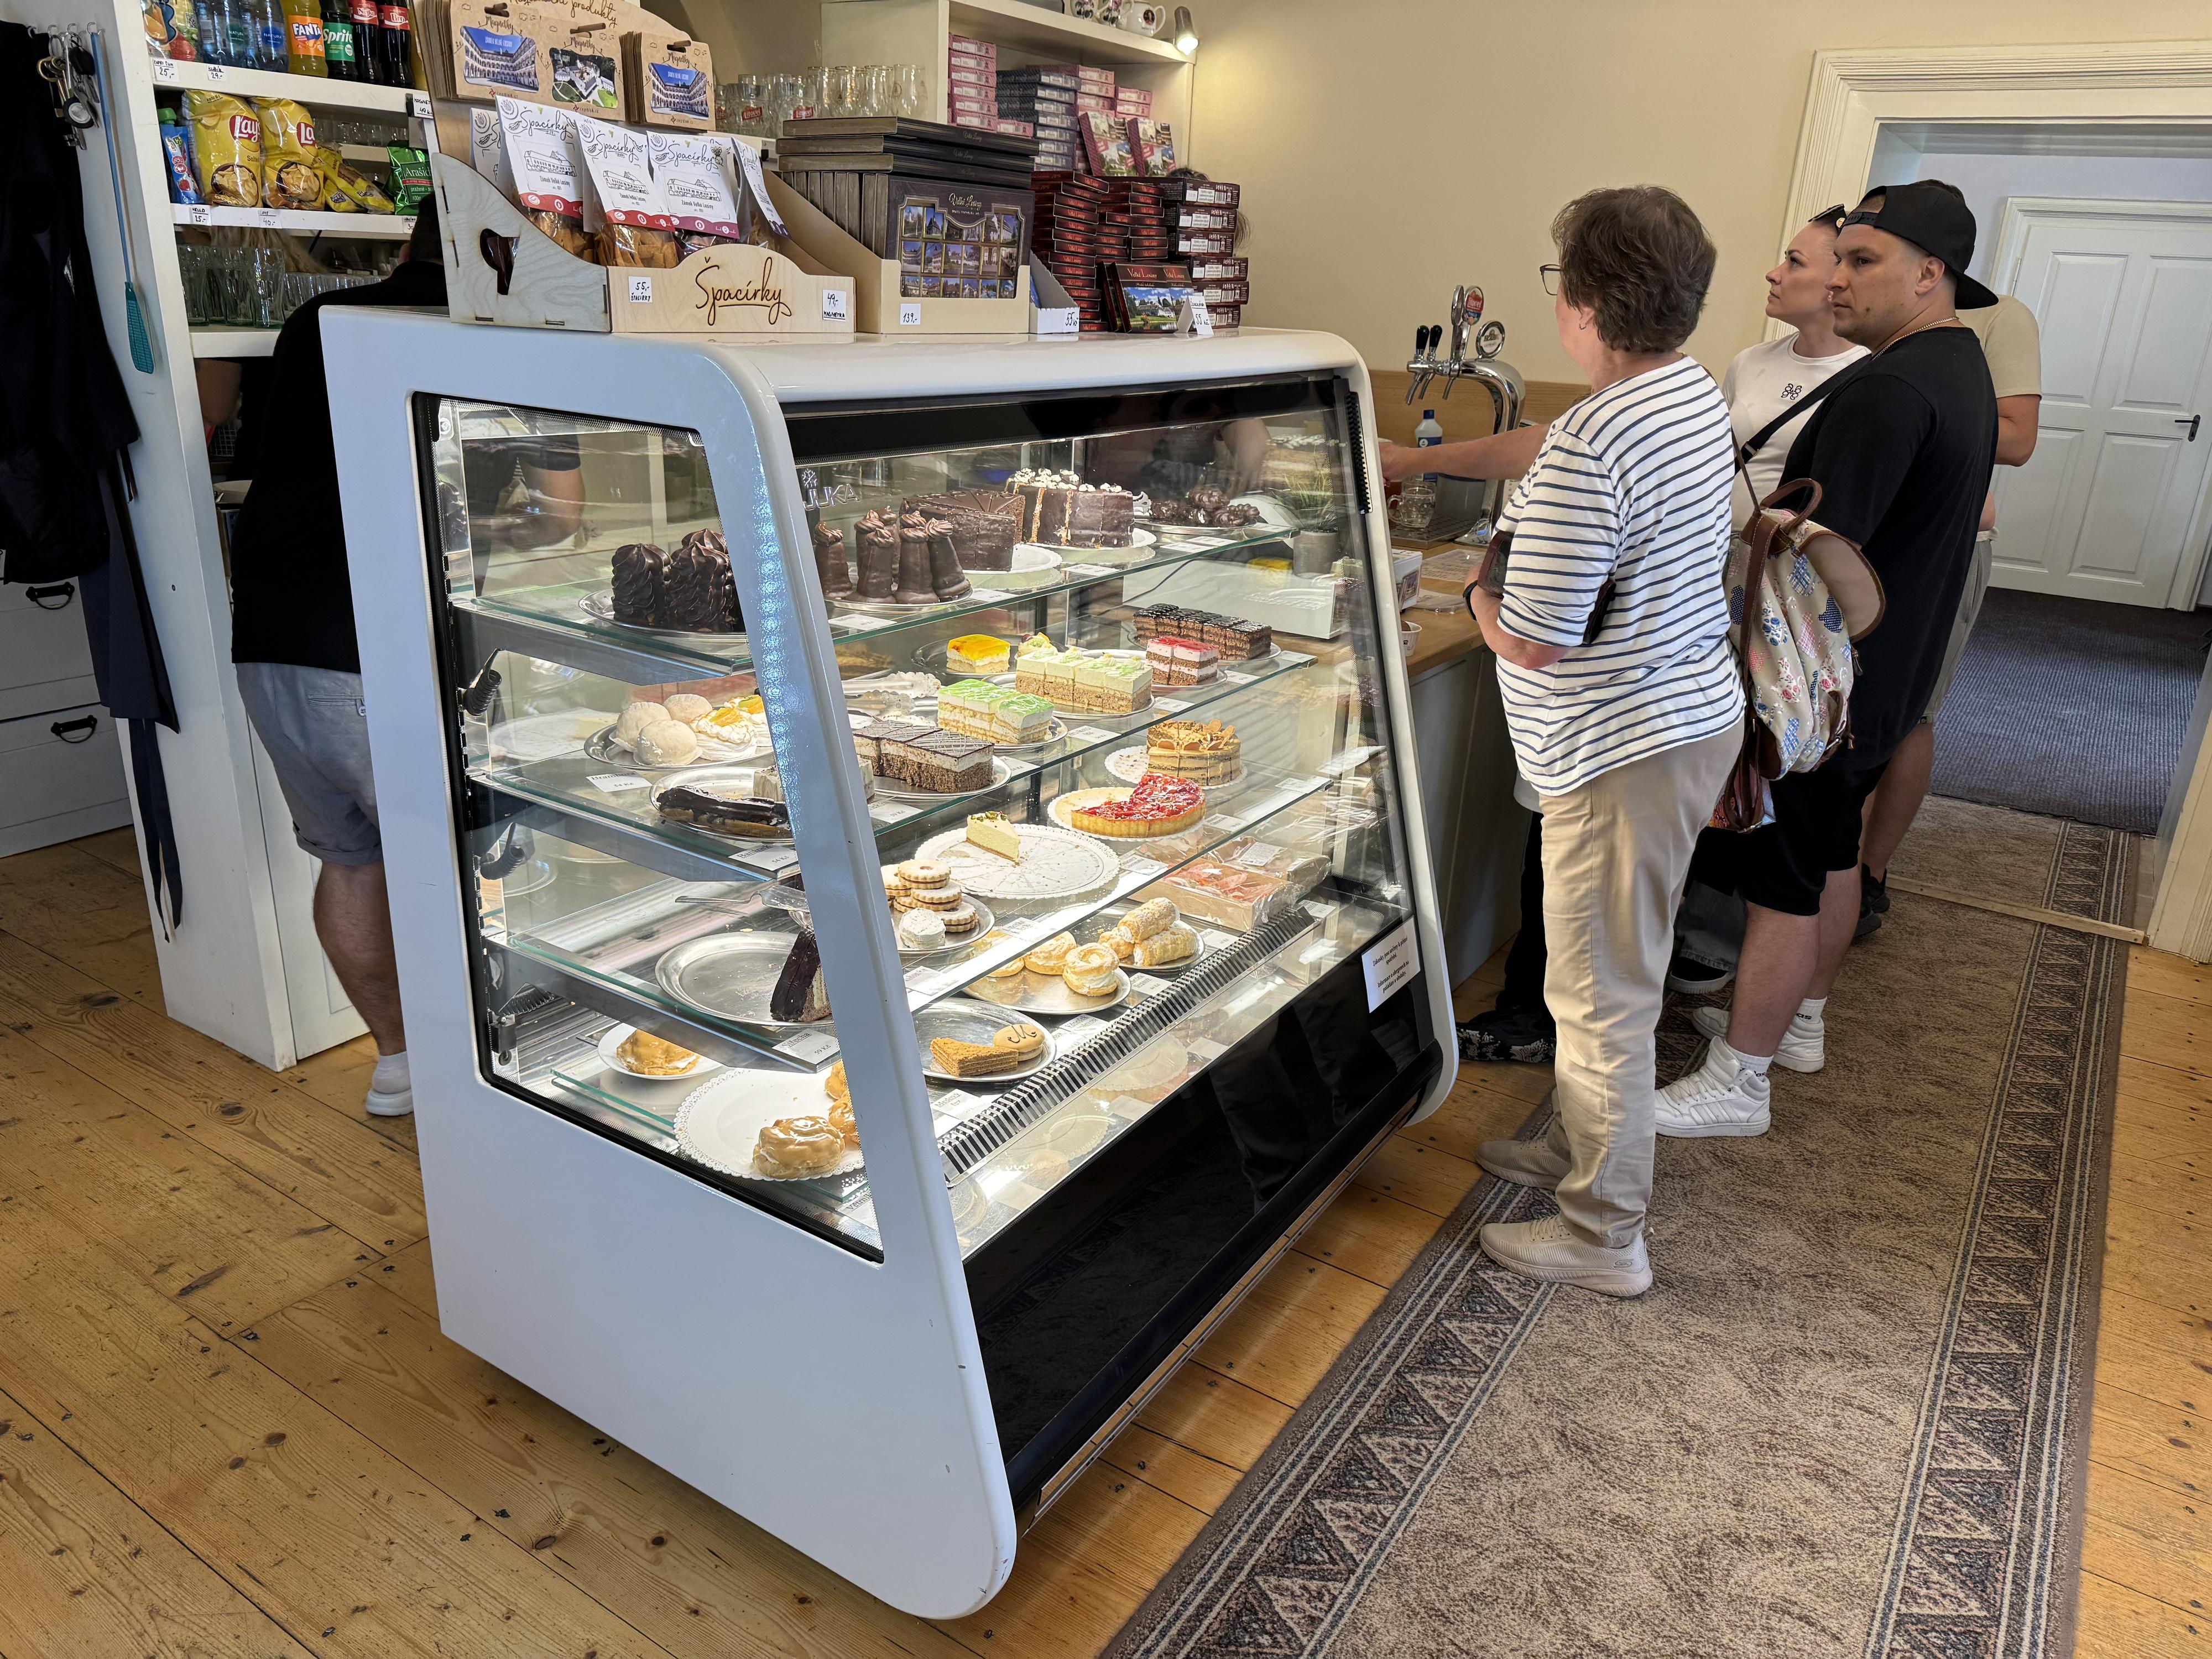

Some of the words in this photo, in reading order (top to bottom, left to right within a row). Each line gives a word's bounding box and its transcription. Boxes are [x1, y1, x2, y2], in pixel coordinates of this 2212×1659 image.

[292, 23, 321, 36] FANTA
[486, 16, 513, 35] Magnetky
[323, 29, 353, 44] Sprite
[570, 36, 595, 54] Magnetky
[668, 53, 690, 67] Magnetky
[233, 116, 260, 143] Lay
[520, 106, 573, 141] Špacírky
[596, 129, 639, 163] Špacírky
[667, 139, 718, 171] Špacírky
[635, 282, 649, 291] 55,-
[696, 256, 792, 326] Špacírky
[631, 292, 650, 302] ŠPACÍRKY
[903, 313, 917, 323] 139,-
[1066, 312, 1075, 326] 55
[803, 483, 860, 510] JUKA
